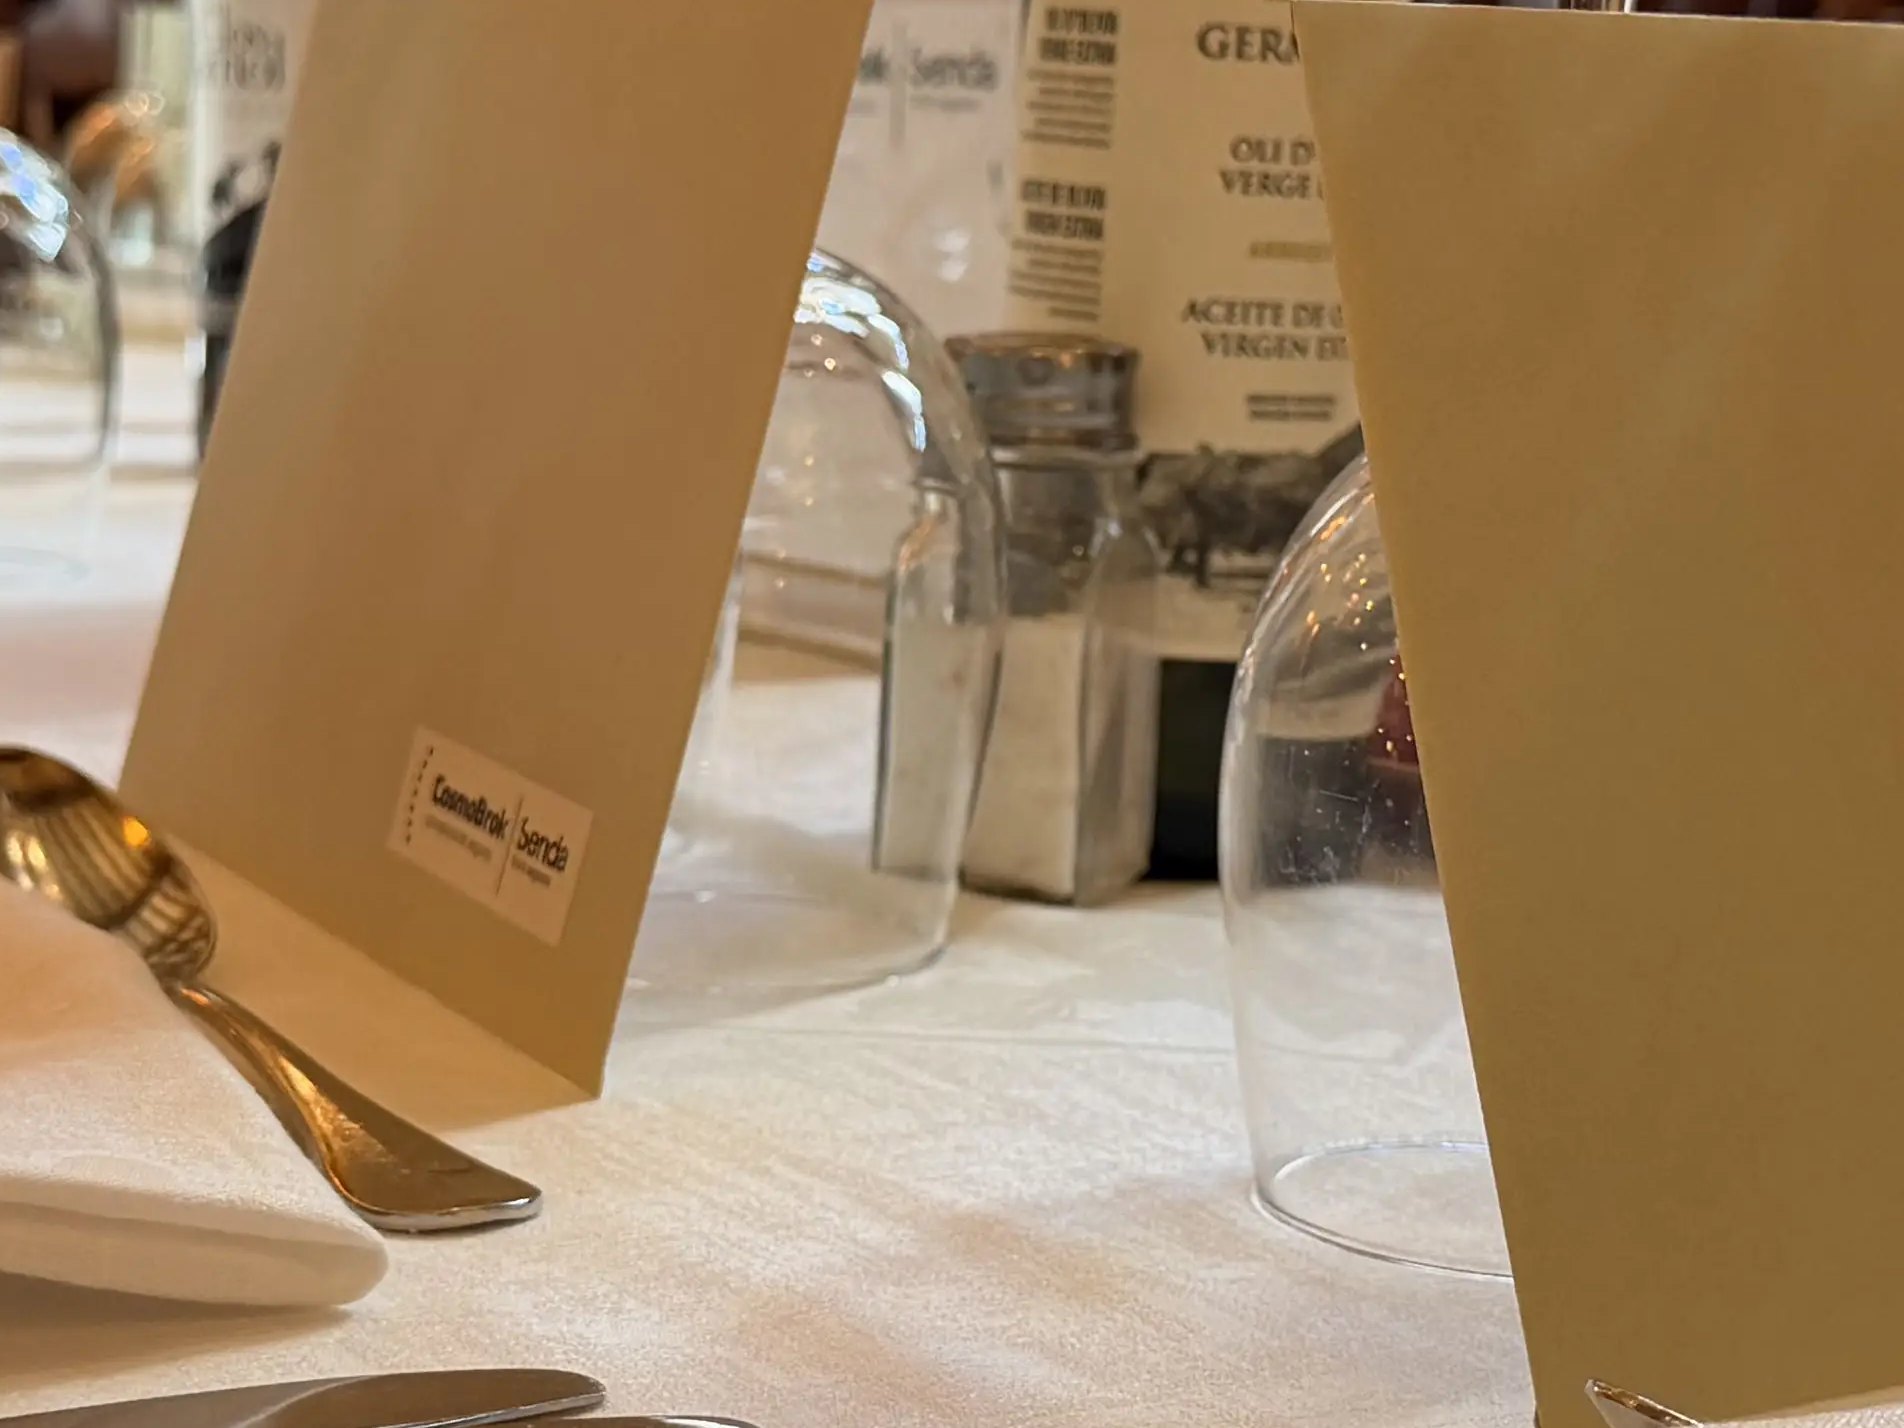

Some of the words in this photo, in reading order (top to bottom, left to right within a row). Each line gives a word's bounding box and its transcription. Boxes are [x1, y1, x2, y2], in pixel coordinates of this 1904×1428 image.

[1228, 135, 1283, 164] OLI
[1218, 169, 1310, 199] VERGE
[1180, 297, 1285, 327] ACEITE
[1292, 301, 1323, 329] DE
[1199, 333, 1309, 359] VIRGEN
[431, 774, 508, 840] CosmoBrok
[516, 817, 569, 873] Senda
